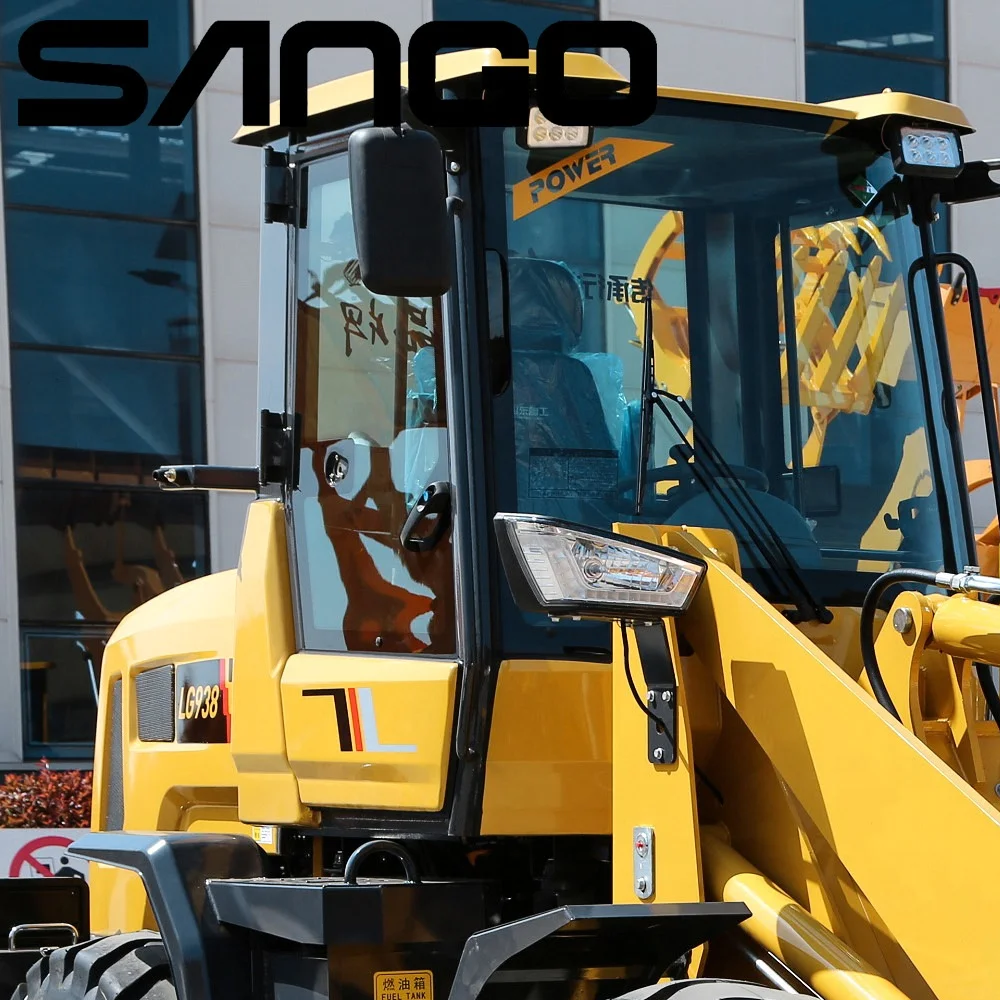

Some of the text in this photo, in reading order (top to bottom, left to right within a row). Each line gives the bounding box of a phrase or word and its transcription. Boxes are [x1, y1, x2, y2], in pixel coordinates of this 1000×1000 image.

[529, 144, 617, 203] POWER
[178, 684, 220, 720] LG938
[381, 991, 426, 1000] FUEL TANK
[383, 976, 425, 991] 燃油箱
